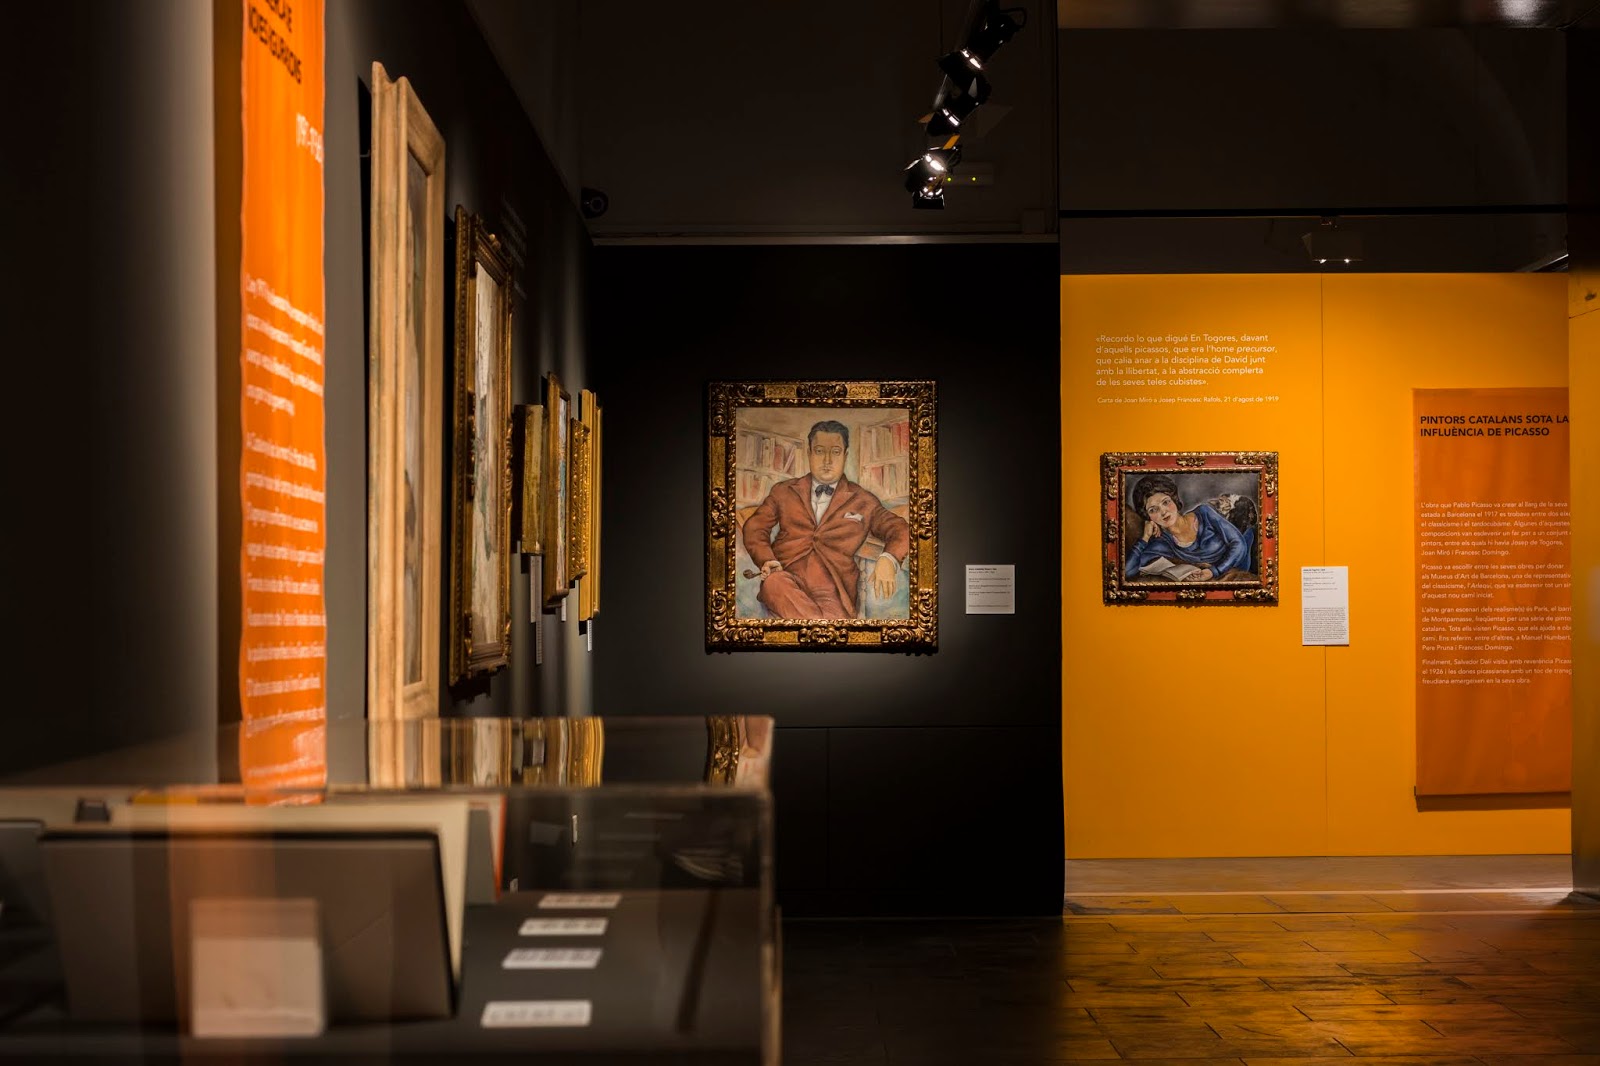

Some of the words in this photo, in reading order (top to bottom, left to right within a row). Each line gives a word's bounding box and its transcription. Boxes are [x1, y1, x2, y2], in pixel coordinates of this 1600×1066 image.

[1165, 334, 1188, 344] digué
[1203, 334, 1238, 344] Togores,
[1096, 345, 1132, 355] d'aquells
[1135, 345, 1170, 355] picassos,
[1171, 356, 1209, 365] disciplina
[1250, 355, 1266, 365] junt
[1222, 366, 1264, 376] complerta
[1420, 426, 1484, 436] INFLUÈNCIA
